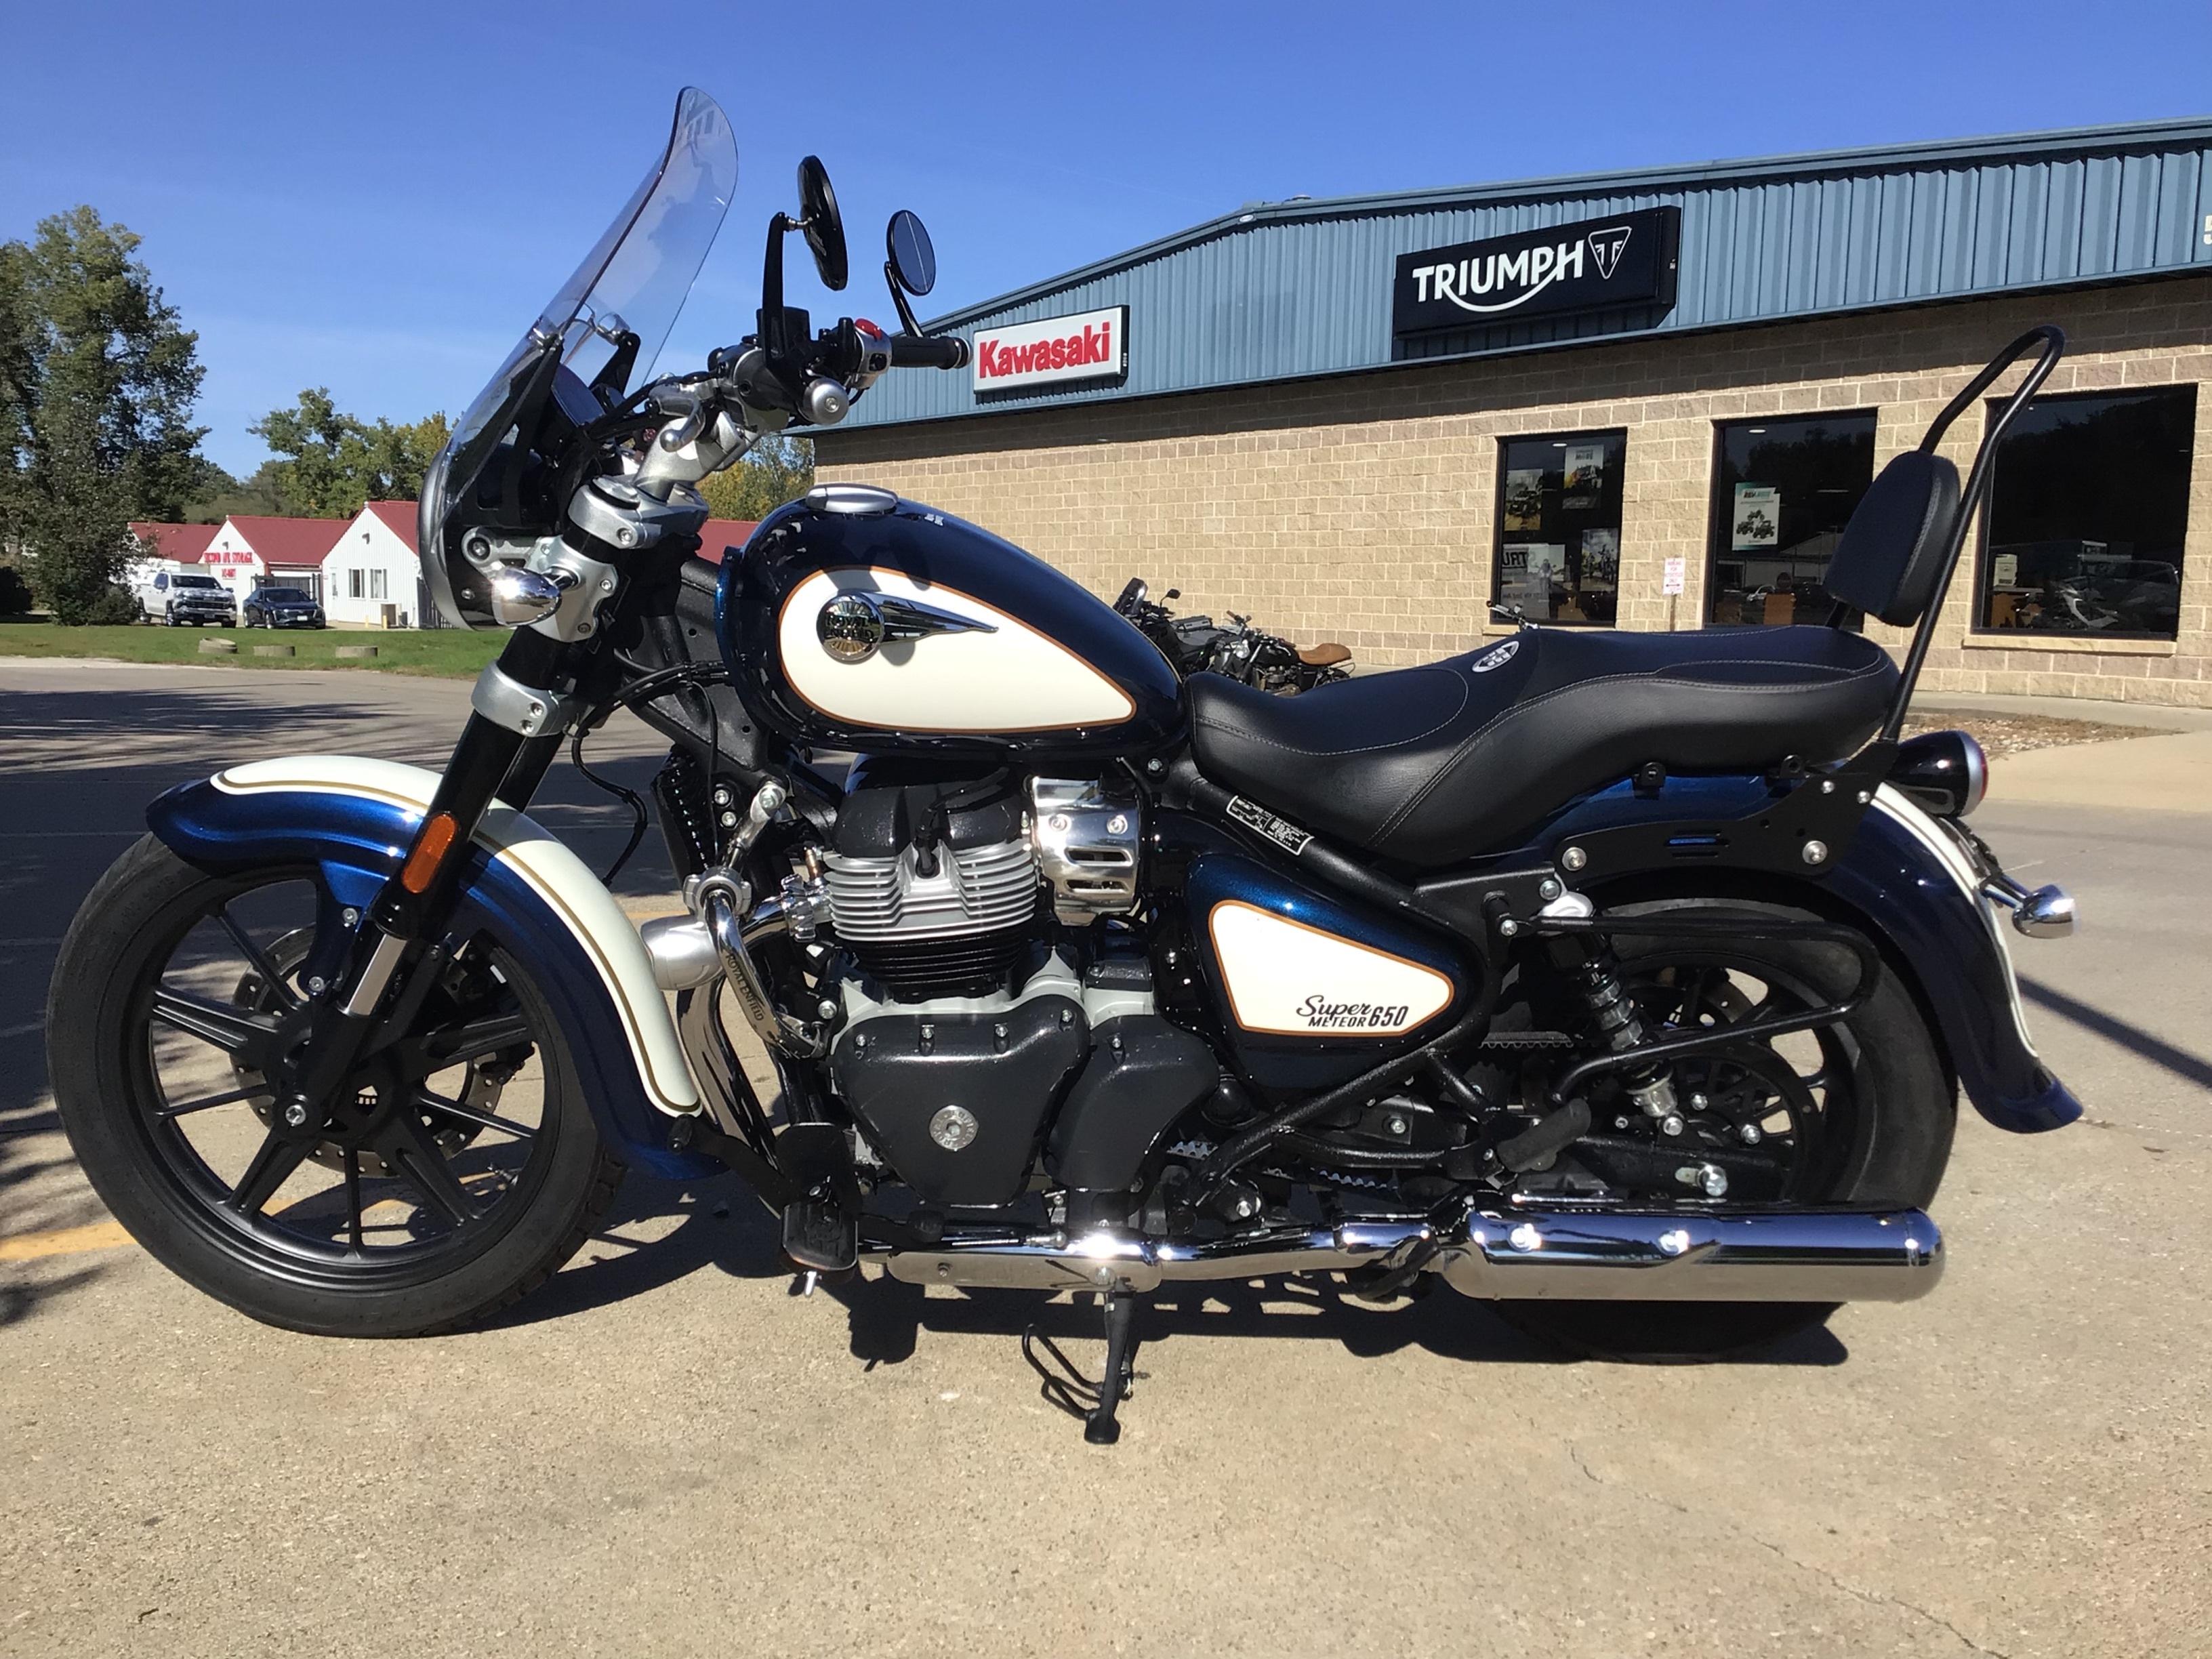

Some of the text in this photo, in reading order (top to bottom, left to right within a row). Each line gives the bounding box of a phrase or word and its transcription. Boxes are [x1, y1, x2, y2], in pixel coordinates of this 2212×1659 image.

[1412, 240, 1584, 312] TRIUMPH
[980, 321, 1110, 379] Kawasaki
[725, 952, 764, 1021] ROYAL ENFIELD
[1296, 995, 1372, 1021] Super
[1308, 1006, 1409, 1027] METEOR 650
